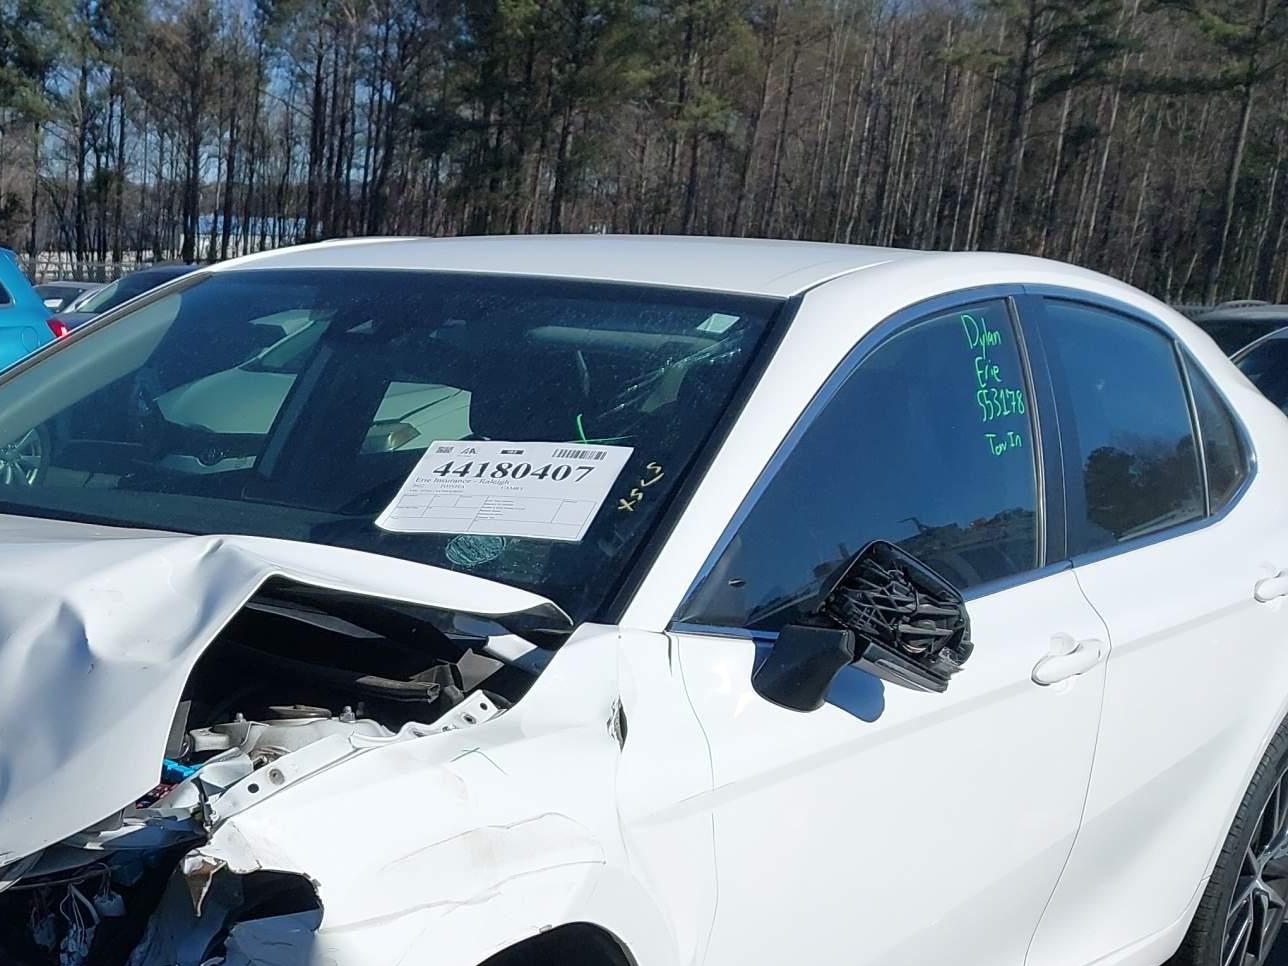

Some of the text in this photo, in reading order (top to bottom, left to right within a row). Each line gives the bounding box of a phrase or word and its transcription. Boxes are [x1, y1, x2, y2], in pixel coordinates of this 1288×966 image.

[961, 314, 1002, 360] Dylan
[975, 356, 1003, 388] Erie
[432, 460, 596, 483] 44180407
